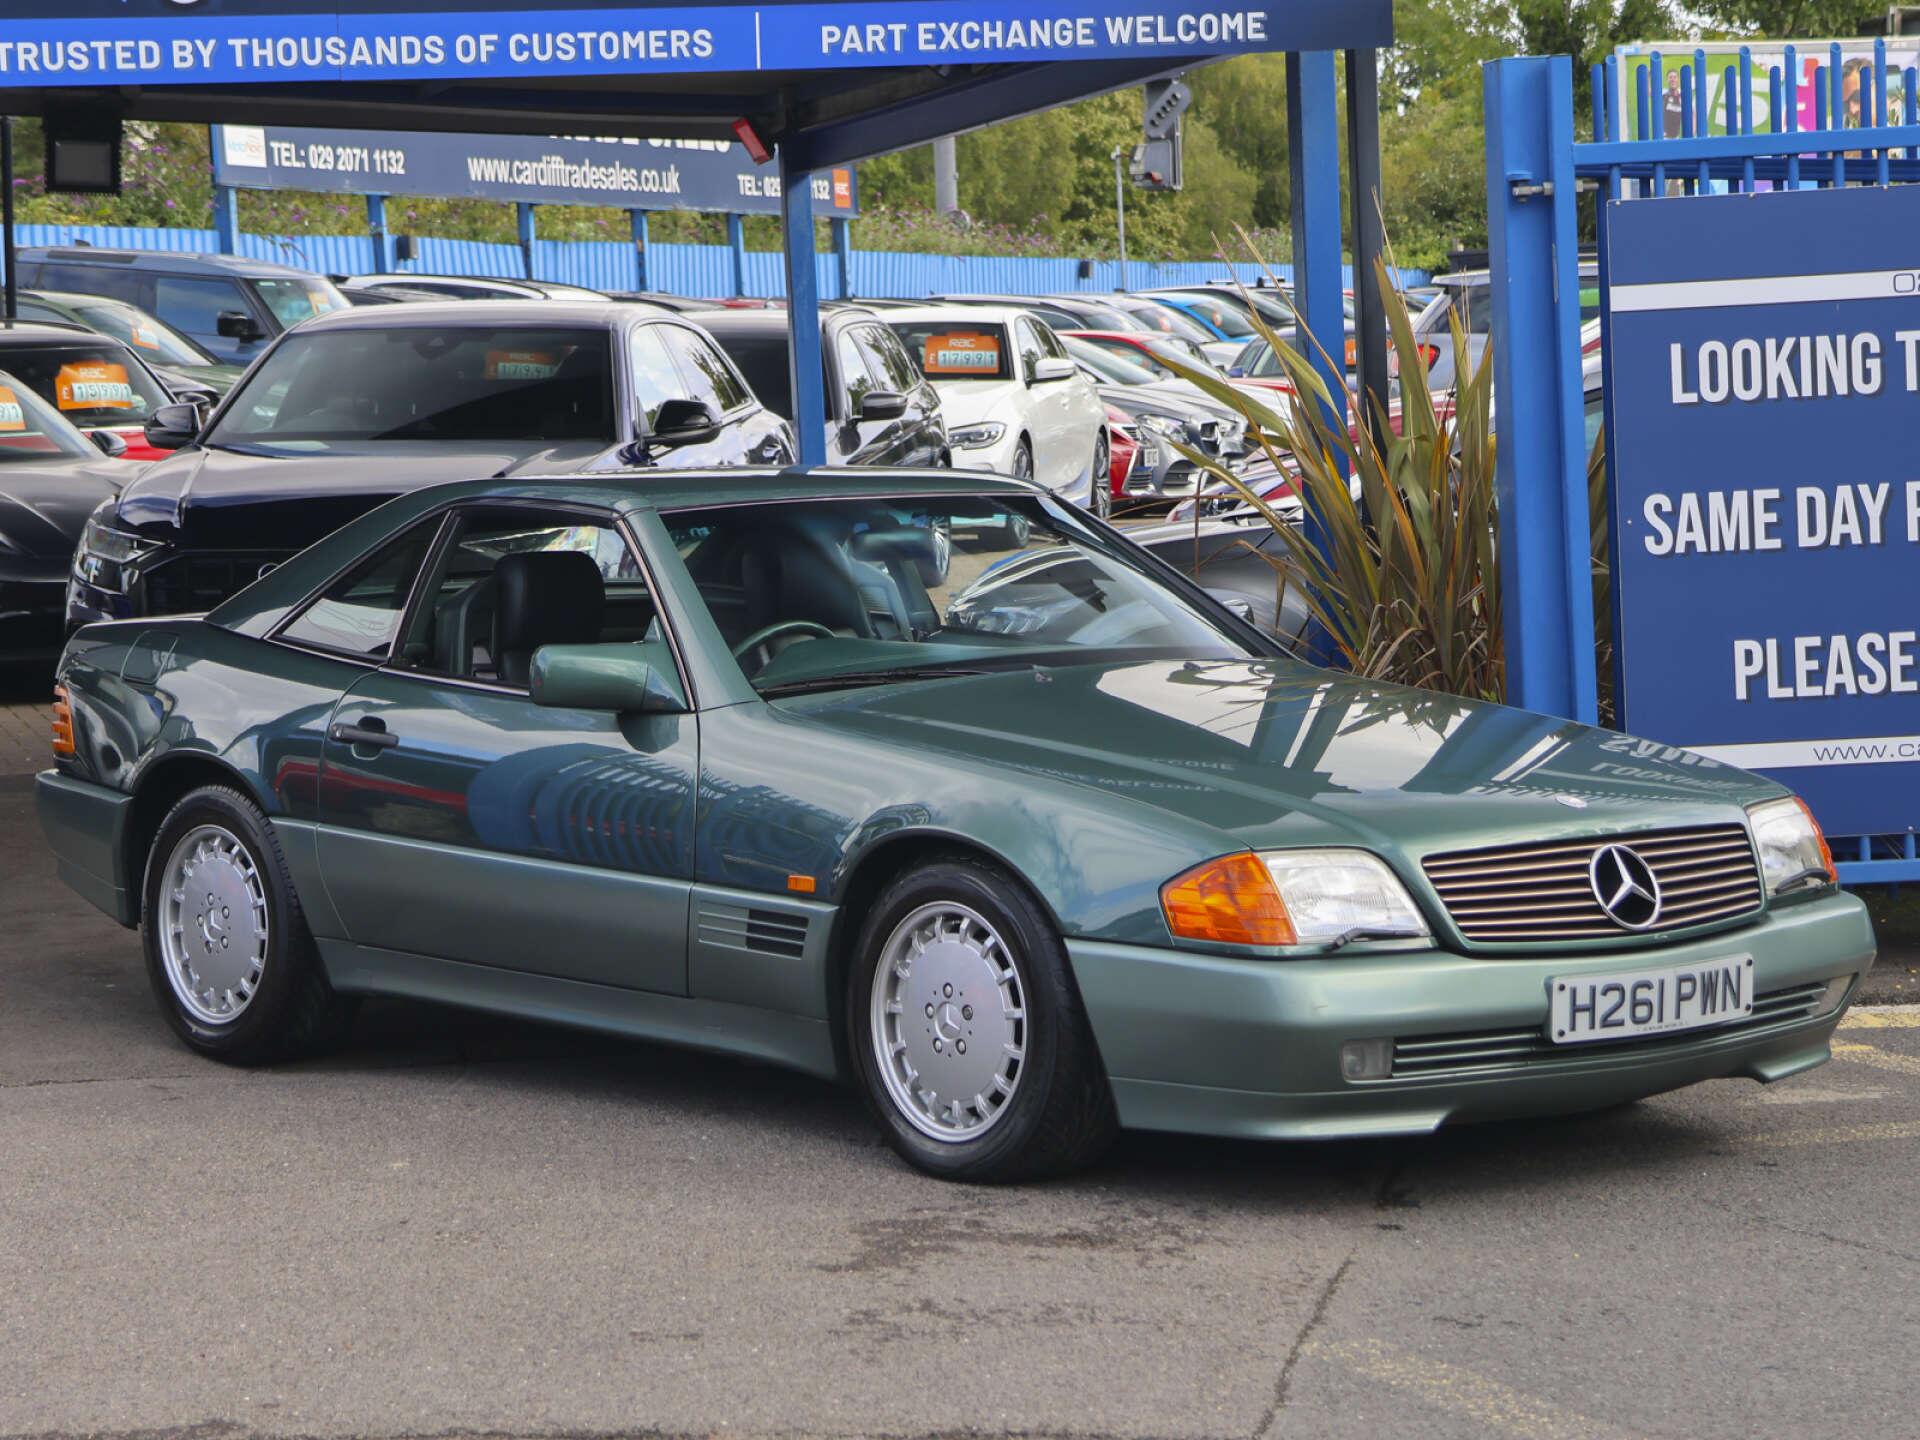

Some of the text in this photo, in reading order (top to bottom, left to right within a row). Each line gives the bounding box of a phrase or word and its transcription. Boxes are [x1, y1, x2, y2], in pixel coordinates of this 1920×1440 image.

[0, 29, 712, 72] TRUSTED BY THOUSANDS OF CUSTOMERS
[821, 12, 1266, 53] PART EXCHANGE WELCOME
[270, 141, 305, 168] TEL:
[309, 144, 333, 170] 029
[337, 146, 369, 172] 2071
[373, 150, 405, 174] 1132
[467, 155, 681, 194] www.cardifftradesales.co.uk
[737, 174, 762, 196] TEL:
[1893, 273, 1920, 293] 0
[1670, 332, 1882, 403] LOOKING
[1643, 488, 1782, 555] SAME
[1796, 483, 1890, 547] DAY
[1734, 631, 1918, 700] PLEASE
[1813, 743, 1920, 761] www.c
[1569, 965, 1741, 1031] H261 PWN
